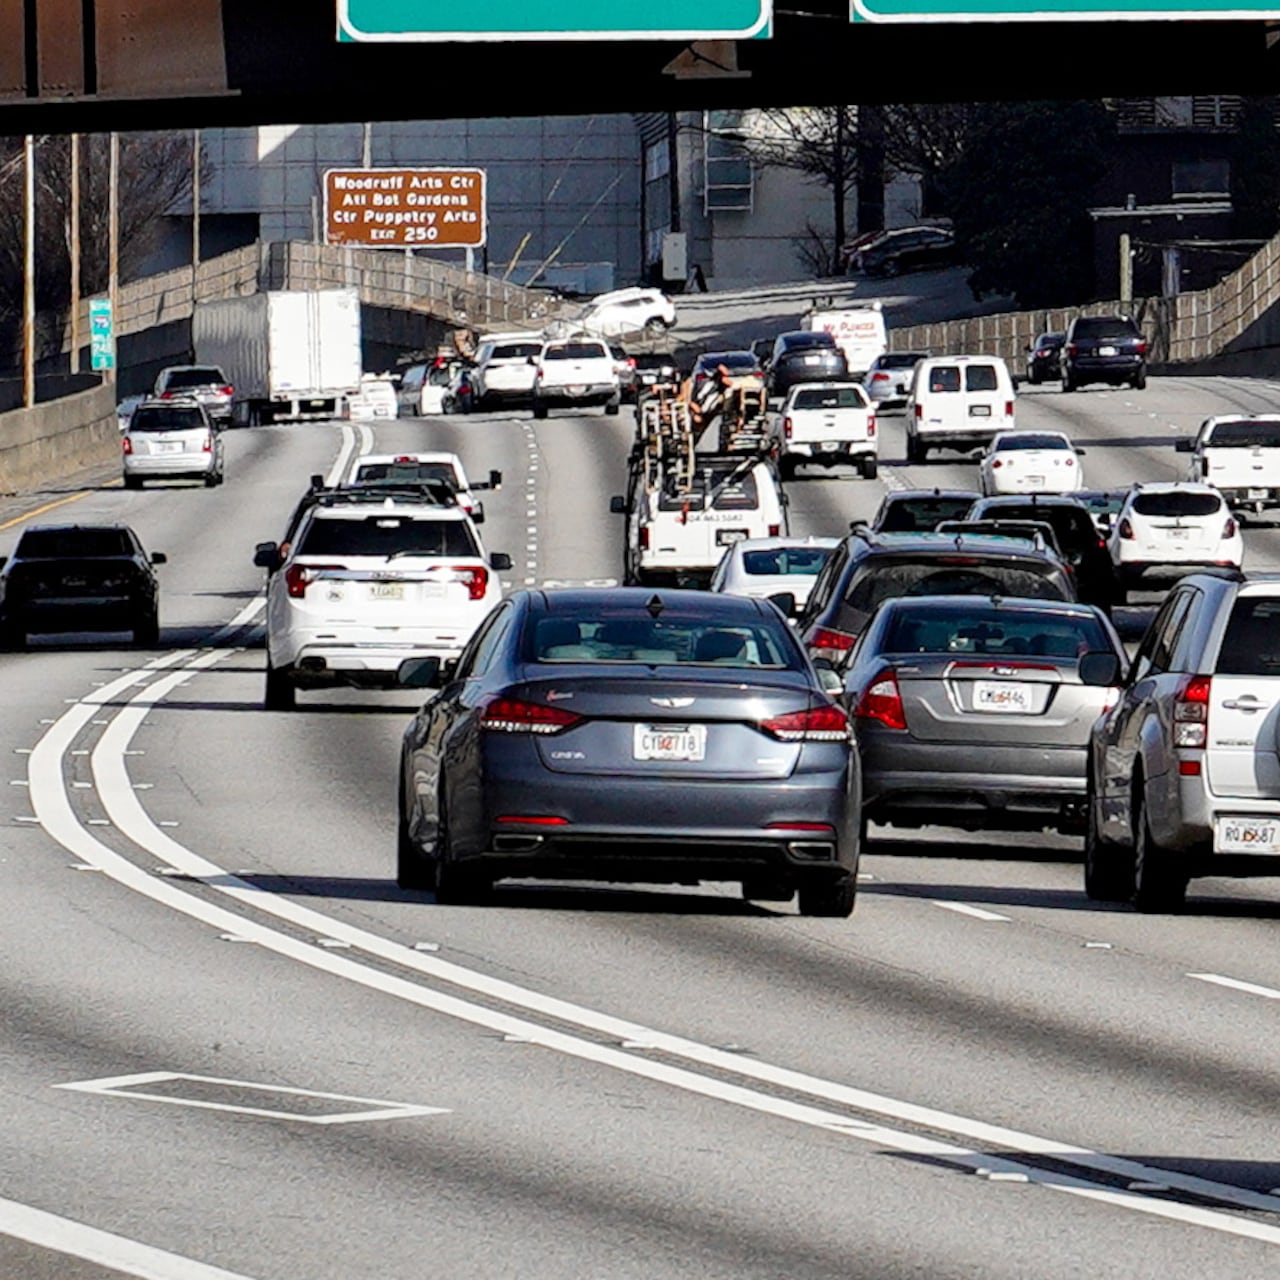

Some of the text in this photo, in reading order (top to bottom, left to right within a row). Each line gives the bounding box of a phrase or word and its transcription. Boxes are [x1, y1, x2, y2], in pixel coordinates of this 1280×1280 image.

[334, 176, 474, 190] Woodruff Arts Ctr
[342, 193, 468, 206] Atl Bot Gardens
[333, 210, 477, 225] Ctr Puppetry Arts
[370, 227, 438, 241] EXIT 250
